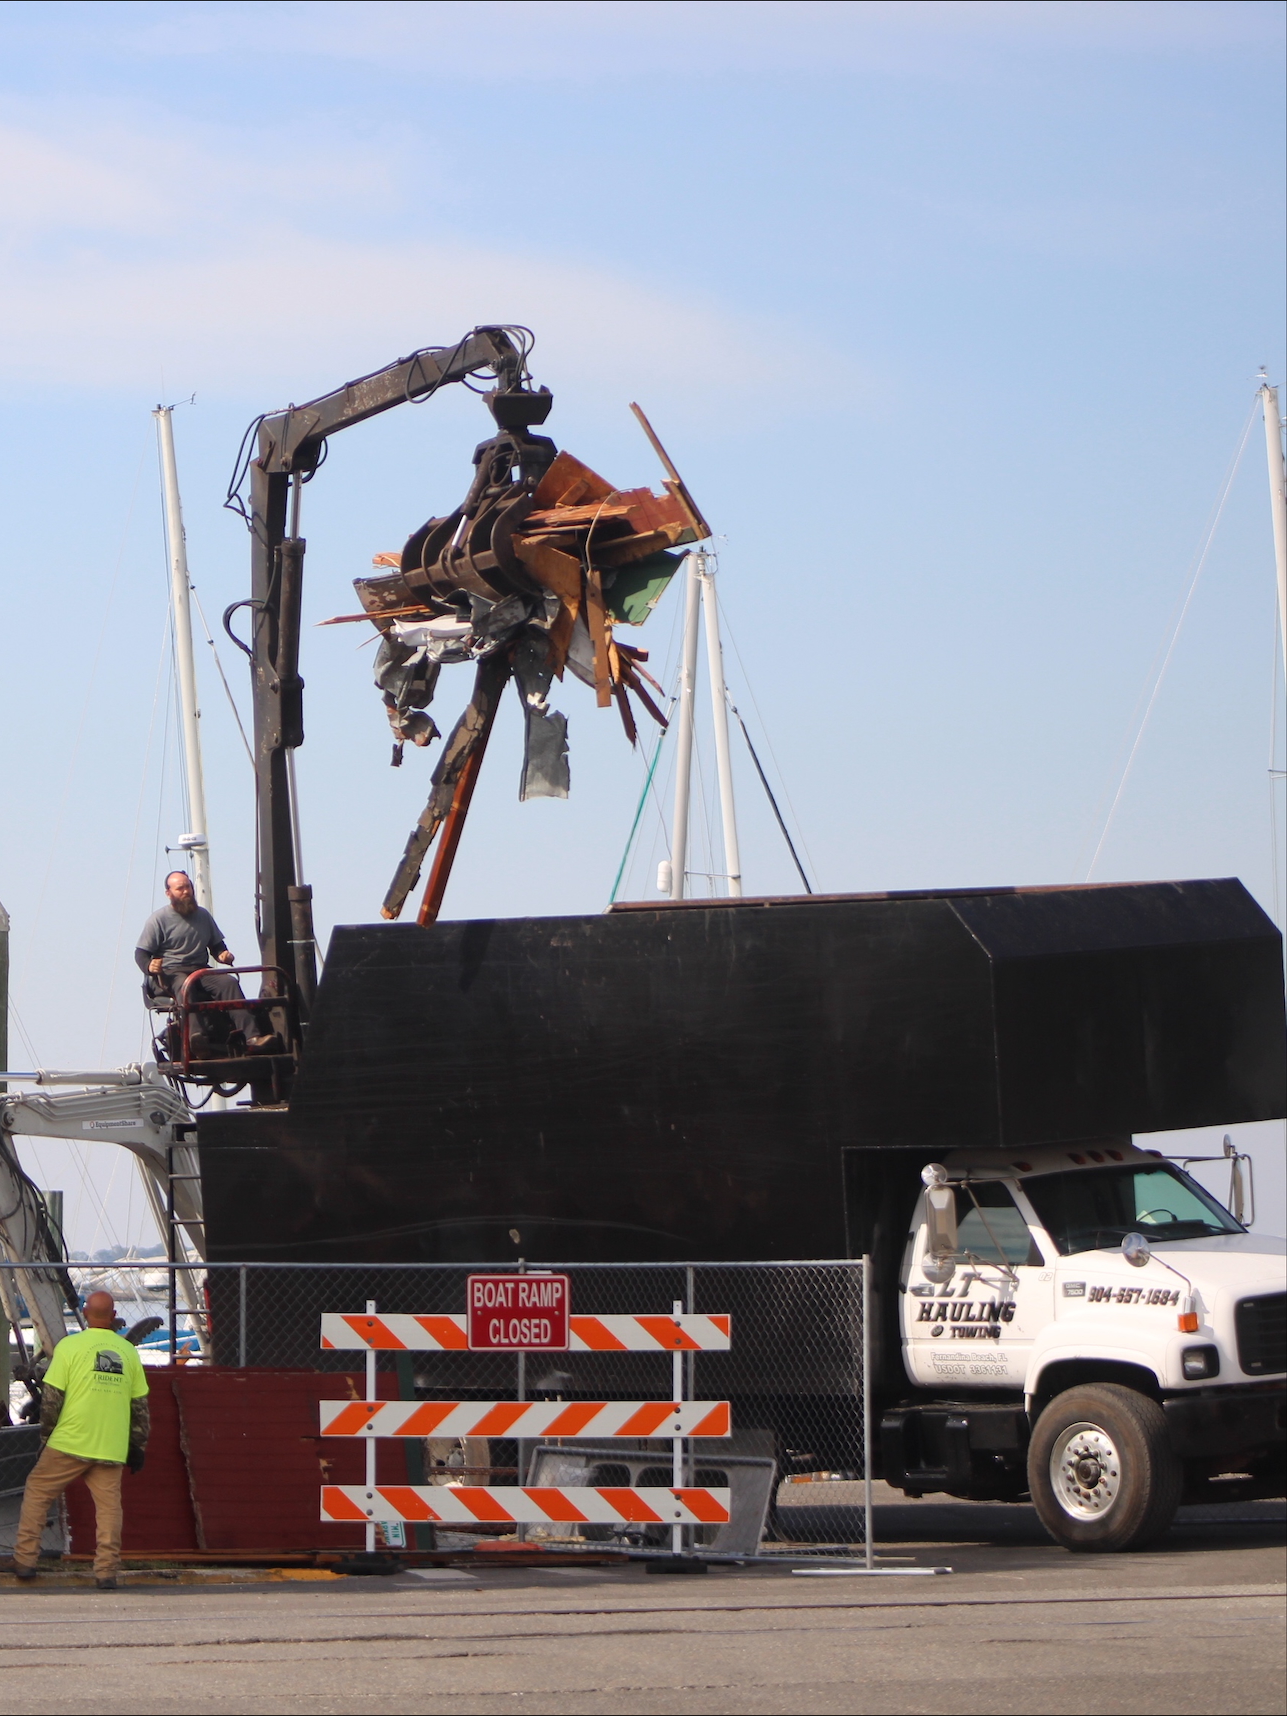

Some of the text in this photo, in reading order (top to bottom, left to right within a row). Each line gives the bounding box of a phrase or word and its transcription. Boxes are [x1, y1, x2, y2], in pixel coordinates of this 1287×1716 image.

[95, 1120, 136, 1128] EquipmentShare
[474, 1282, 562, 1308] BOAT RAMP
[1087, 1286, 1181, 1306] 904-557-1684
[916, 1300, 1016, 1322] HAULING
[489, 1318, 551, 1344] CLOSED
[950, 1324, 1001, 1338] TOWING
[931, 1352, 1008, 1363] Fernandina Beach, FL
[934, 1364, 965, 1374] USDOT
[93, 1373, 123, 1383] TRIDENT
